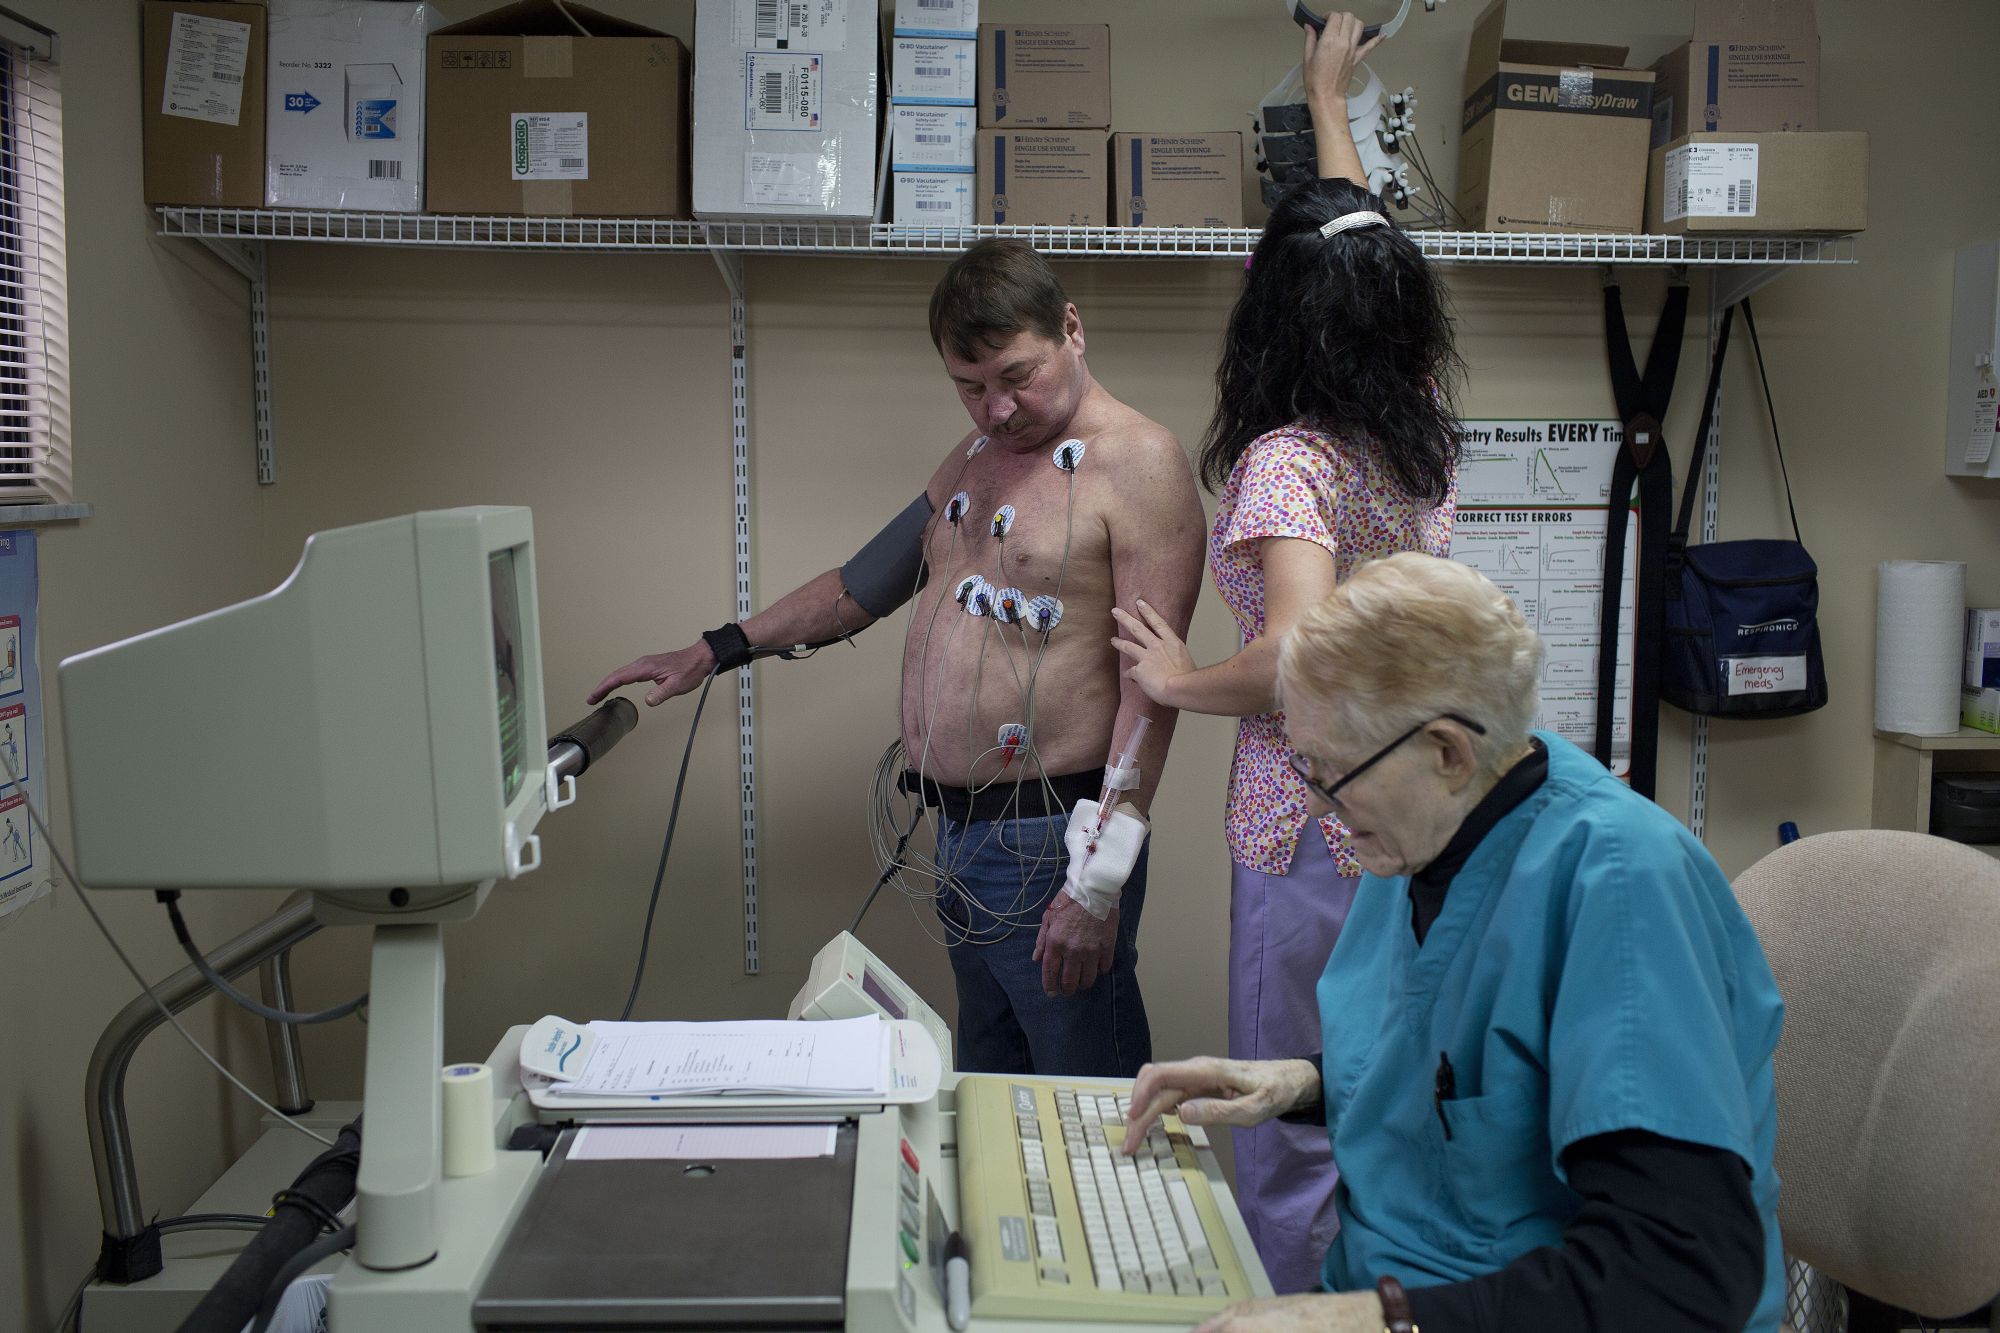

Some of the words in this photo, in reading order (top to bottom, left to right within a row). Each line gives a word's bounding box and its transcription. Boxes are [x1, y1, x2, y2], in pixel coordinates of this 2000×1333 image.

[279, 61, 301, 69] Reorder
[800, 67, 809, 118] F0115-080
[1507, 84, 1559, 104] GEM
[288, 97, 304, 107] 30
[515, 122, 528, 169] Hospitak
[1495, 426, 1543, 443] Results
[1548, 423, 1599, 442] EVERY
[1603, 427, 1624, 442] Tim
[1456, 513, 1501, 522] CORRECT
[1505, 513, 1528, 522] TEST
[1532, 512, 1572, 522] ERRORS
[1737, 623, 1798, 636] RESPIRONICS
[1735, 663, 1784, 681] Emergency
[1744, 679, 1774, 689] meds
